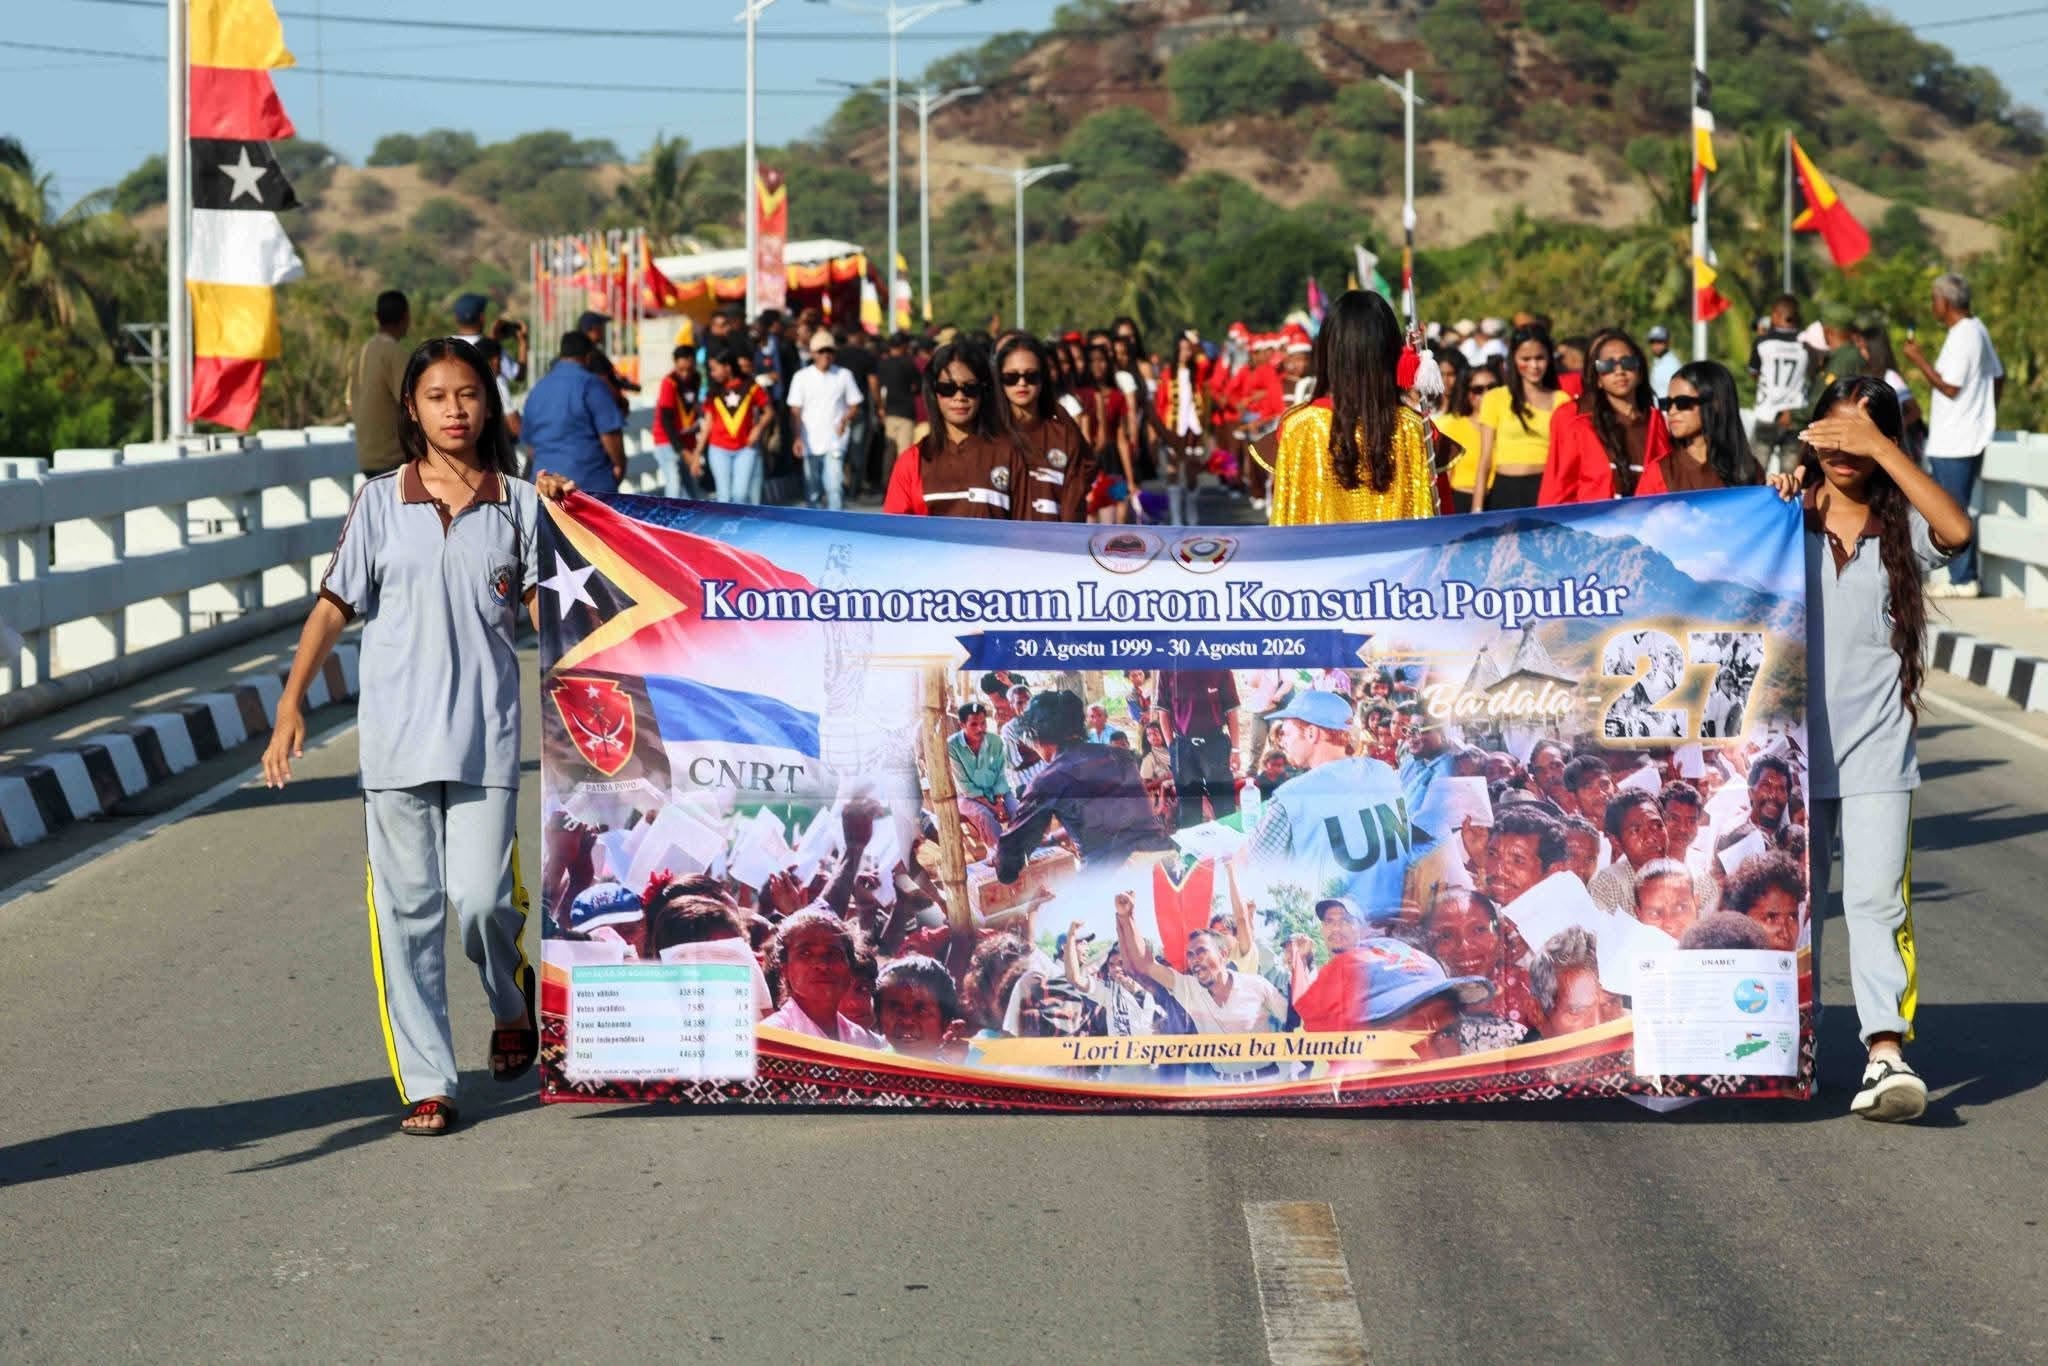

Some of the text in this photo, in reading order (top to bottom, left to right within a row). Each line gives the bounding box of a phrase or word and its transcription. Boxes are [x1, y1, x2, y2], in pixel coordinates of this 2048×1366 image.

[1774, 358, 1798, 388] 17
[701, 572, 1629, 630] Komemorasaun Loron Konsulta Populár
[1015, 638, 1038, 657] 30
[1043, 637, 1105, 661] Agostu
[1110, 638, 1153, 657] 1999
[1167, 638, 1191, 657] 30
[1195, 638, 1258, 660] Agostu
[1262, 638, 1306, 657] 2026
[1488, 681, 1573, 717] dala
[1602, 630, 1766, 739] 27
[689, 757, 805, 793] CNRT
[1324, 799, 1410, 873] UN
[1701, 959, 1737, 967] UNAMET
[1126, 1040, 1241, 1063] Esperansa
[1248, 1038, 1276, 1058] ba
